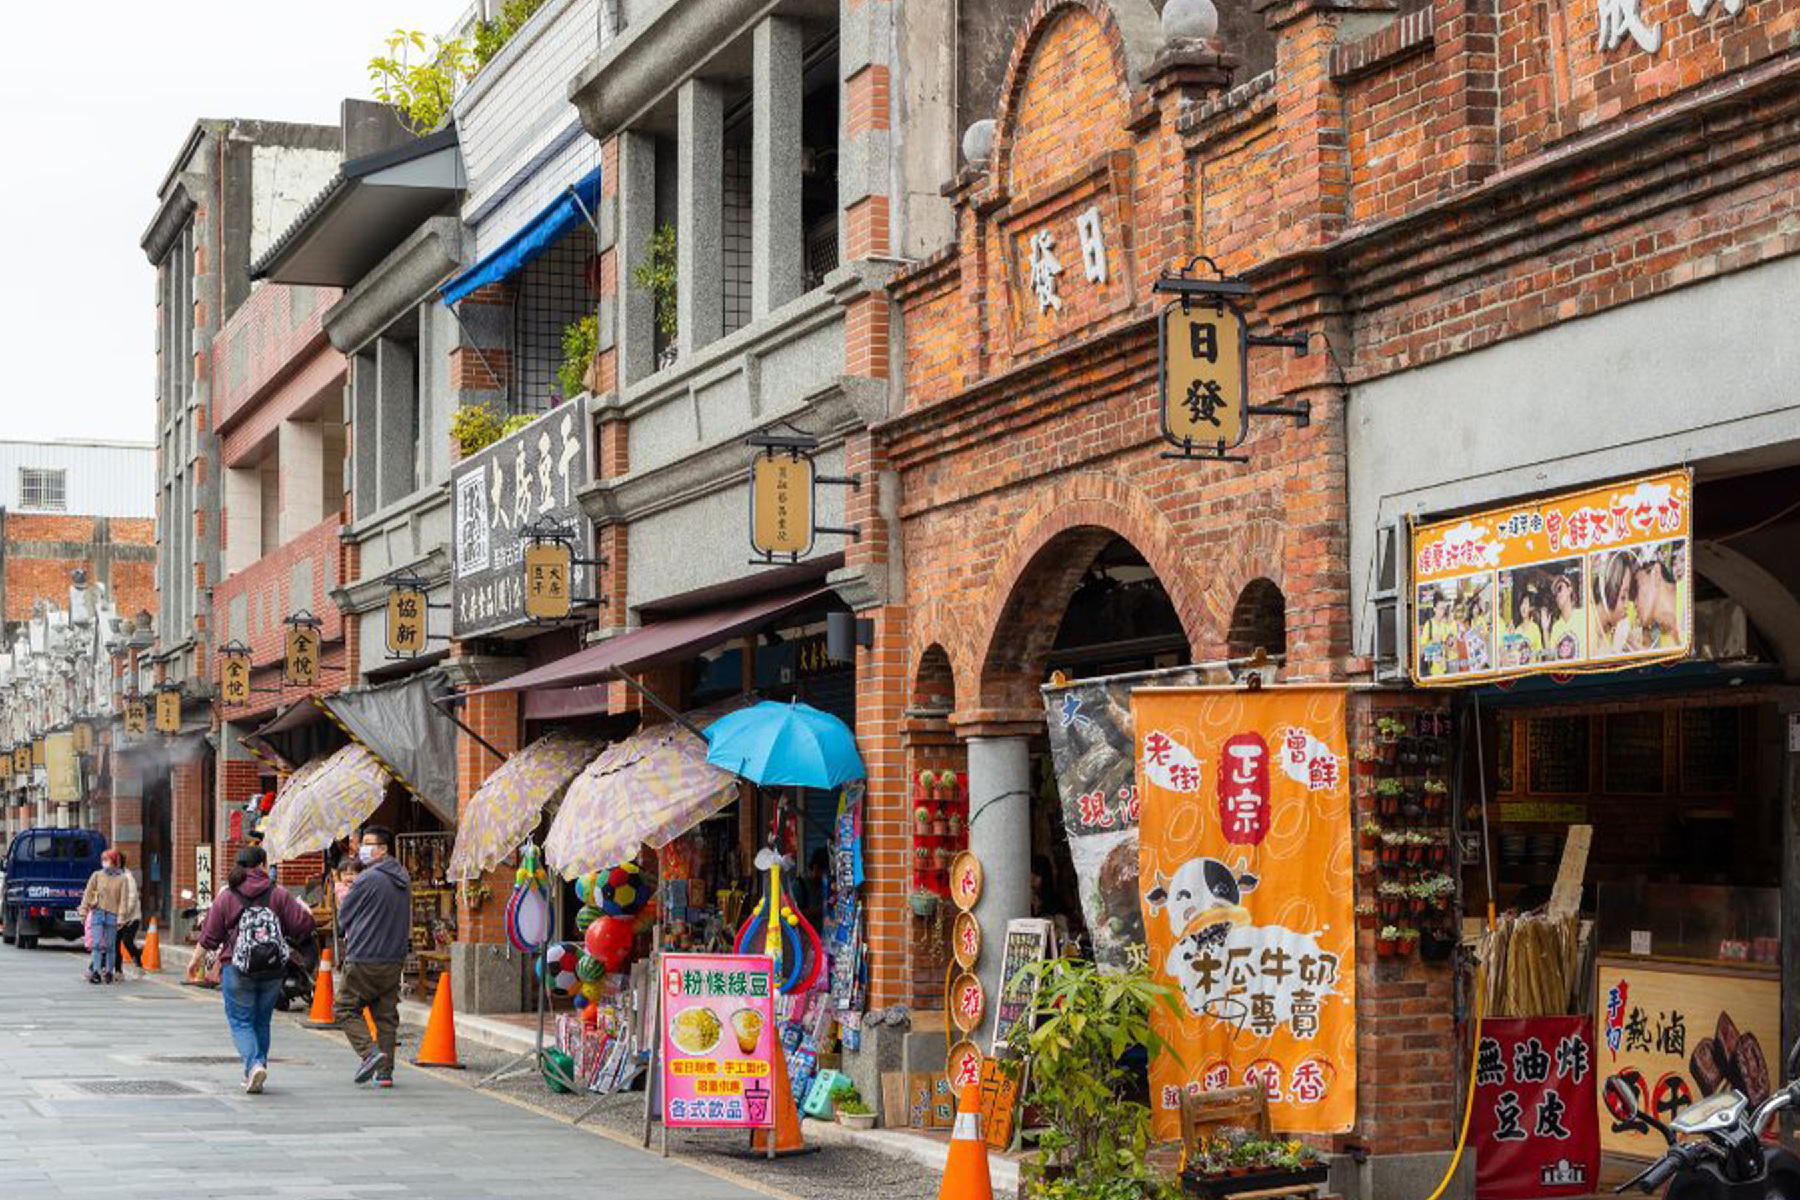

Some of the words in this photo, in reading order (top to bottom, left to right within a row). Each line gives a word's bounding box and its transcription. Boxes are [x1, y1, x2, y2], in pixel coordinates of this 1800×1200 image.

[1181, 321, 1228, 427] 日發
[396, 597, 419, 644] 協新
[1146, 732, 1200, 791] 老街
[1286, 728, 1339, 789] 曾鮮
[1227, 744, 1264, 834] 正宗
[683, 969, 770, 996] 粉條綠豆
[1190, 946, 1339, 995] 木瓜牛奶
[1250, 988, 1319, 1038] 專賣
[1606, 987, 1622, 1053] 手切
[1624, 1006, 1687, 1059] 熱滷
[1476, 1036, 1590, 1084] 無油炸
[670, 1098, 743, 1121] 各式飲品
[1494, 1090, 1571, 1141] 豆皮
